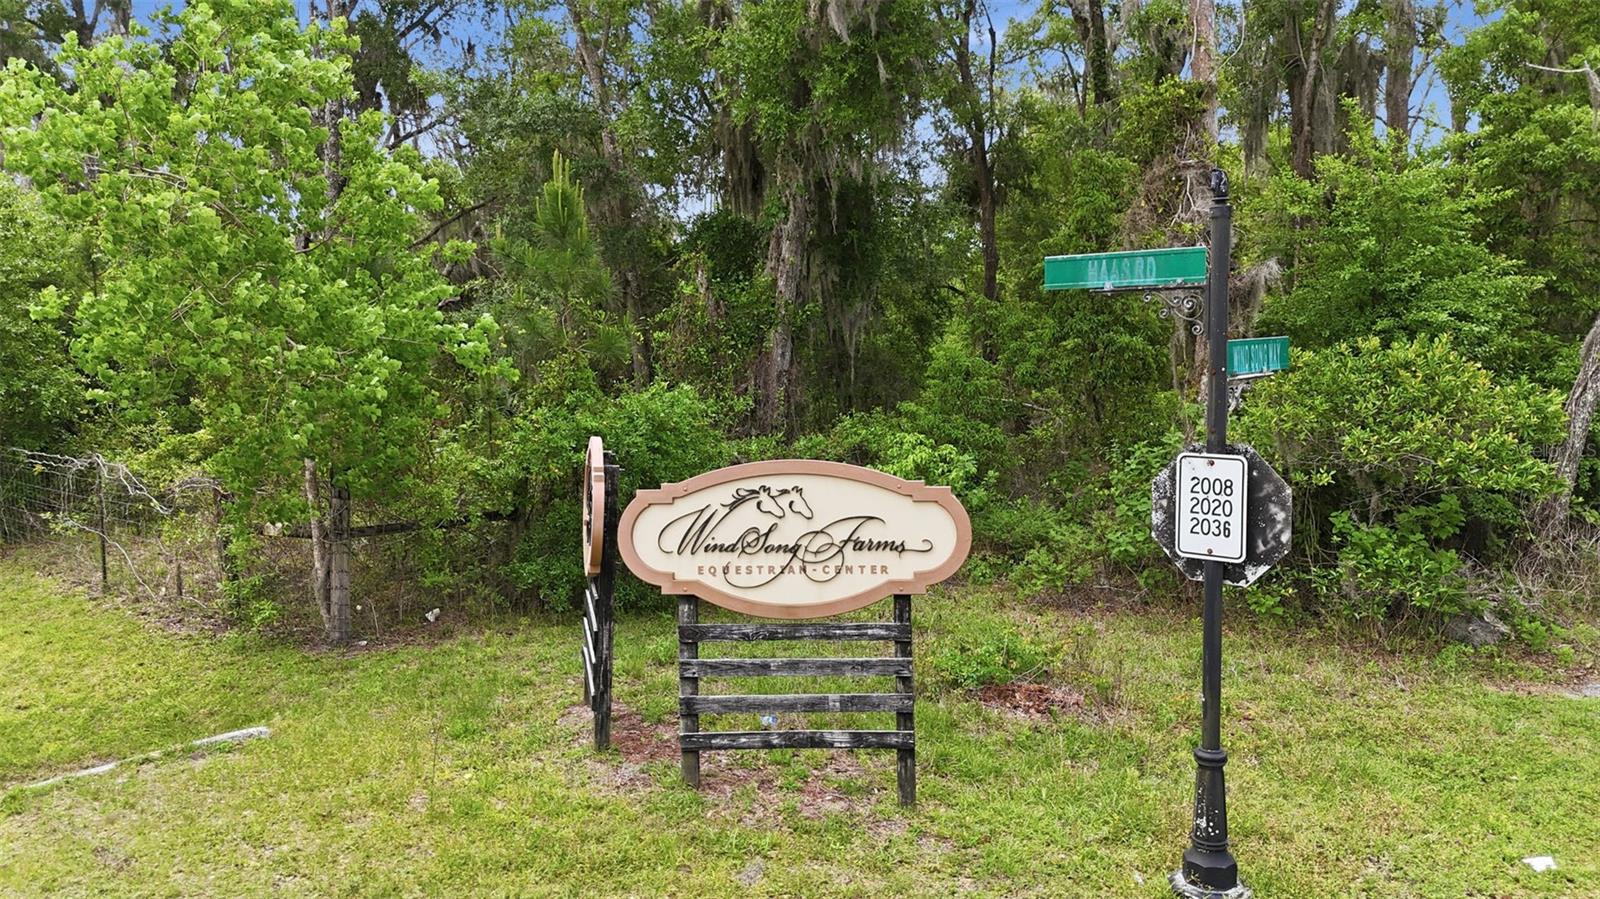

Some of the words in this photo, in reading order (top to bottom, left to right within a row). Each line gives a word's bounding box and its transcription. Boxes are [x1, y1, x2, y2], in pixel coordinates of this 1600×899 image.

[1087, 257, 1131, 283] HAAS
[1135, 256, 1157, 281] RD
[1232, 345, 1250, 371] WIND
[1250, 344, 1268, 370] SONG
[1190, 476, 1234, 497] 2008
[1190, 496, 1233, 518] 2020
[1190, 517, 1232, 538] 2036
[796, 515, 934, 583] Farms
